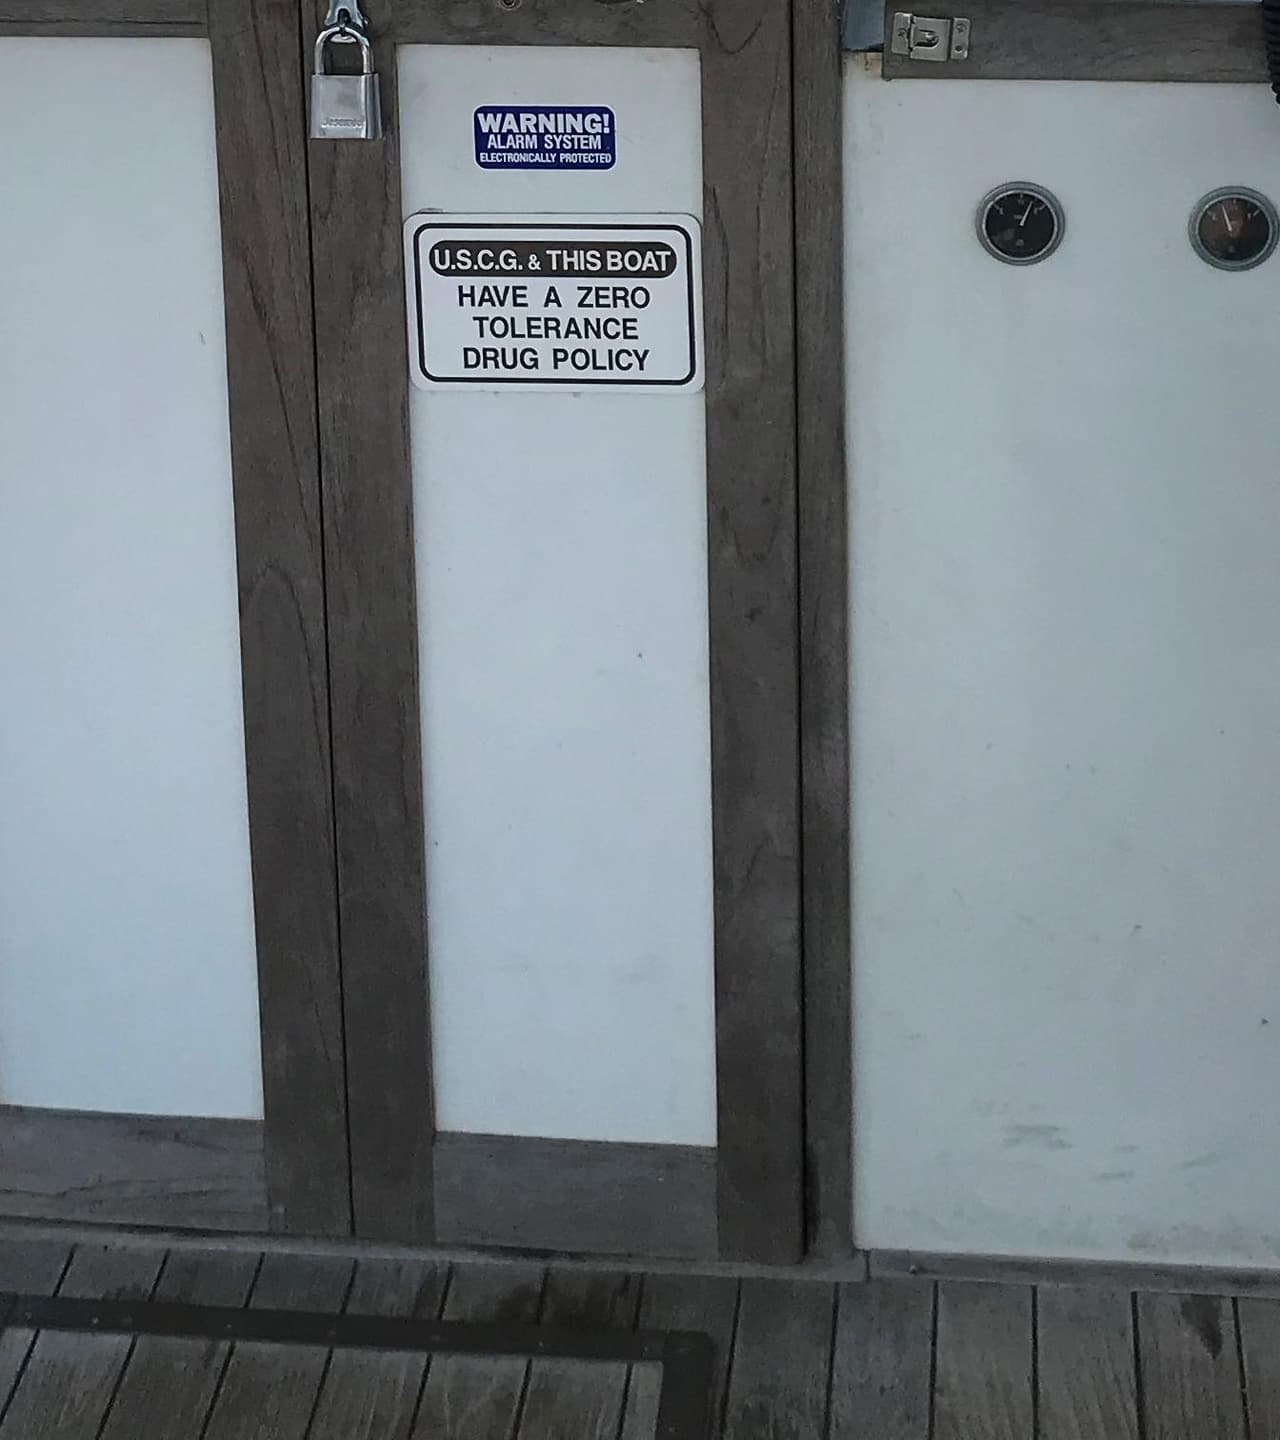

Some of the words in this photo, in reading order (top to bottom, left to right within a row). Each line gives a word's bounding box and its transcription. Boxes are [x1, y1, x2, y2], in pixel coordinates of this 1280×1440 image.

[477, 113, 610, 134] WARNING!
[487, 135, 538, 150] ALARM
[544, 135, 602, 150] SYSTEM
[479, 152, 557, 164] ELECTRONICALLY
[559, 153, 612, 164] PROTECTED
[433, 249, 523, 271] U.S.C.G.
[528, 253, 541, 270] &
[546, 250, 602, 272] THIS
[606, 250, 671, 272] BOAT
[458, 285, 529, 308] HAVE
[543, 286, 563, 308] A
[577, 286, 651, 310] ZERO
[472, 316, 639, 340] TOLERANCE
[462, 347, 539, 370] DRUG
[552, 348, 650, 372] POLICY
